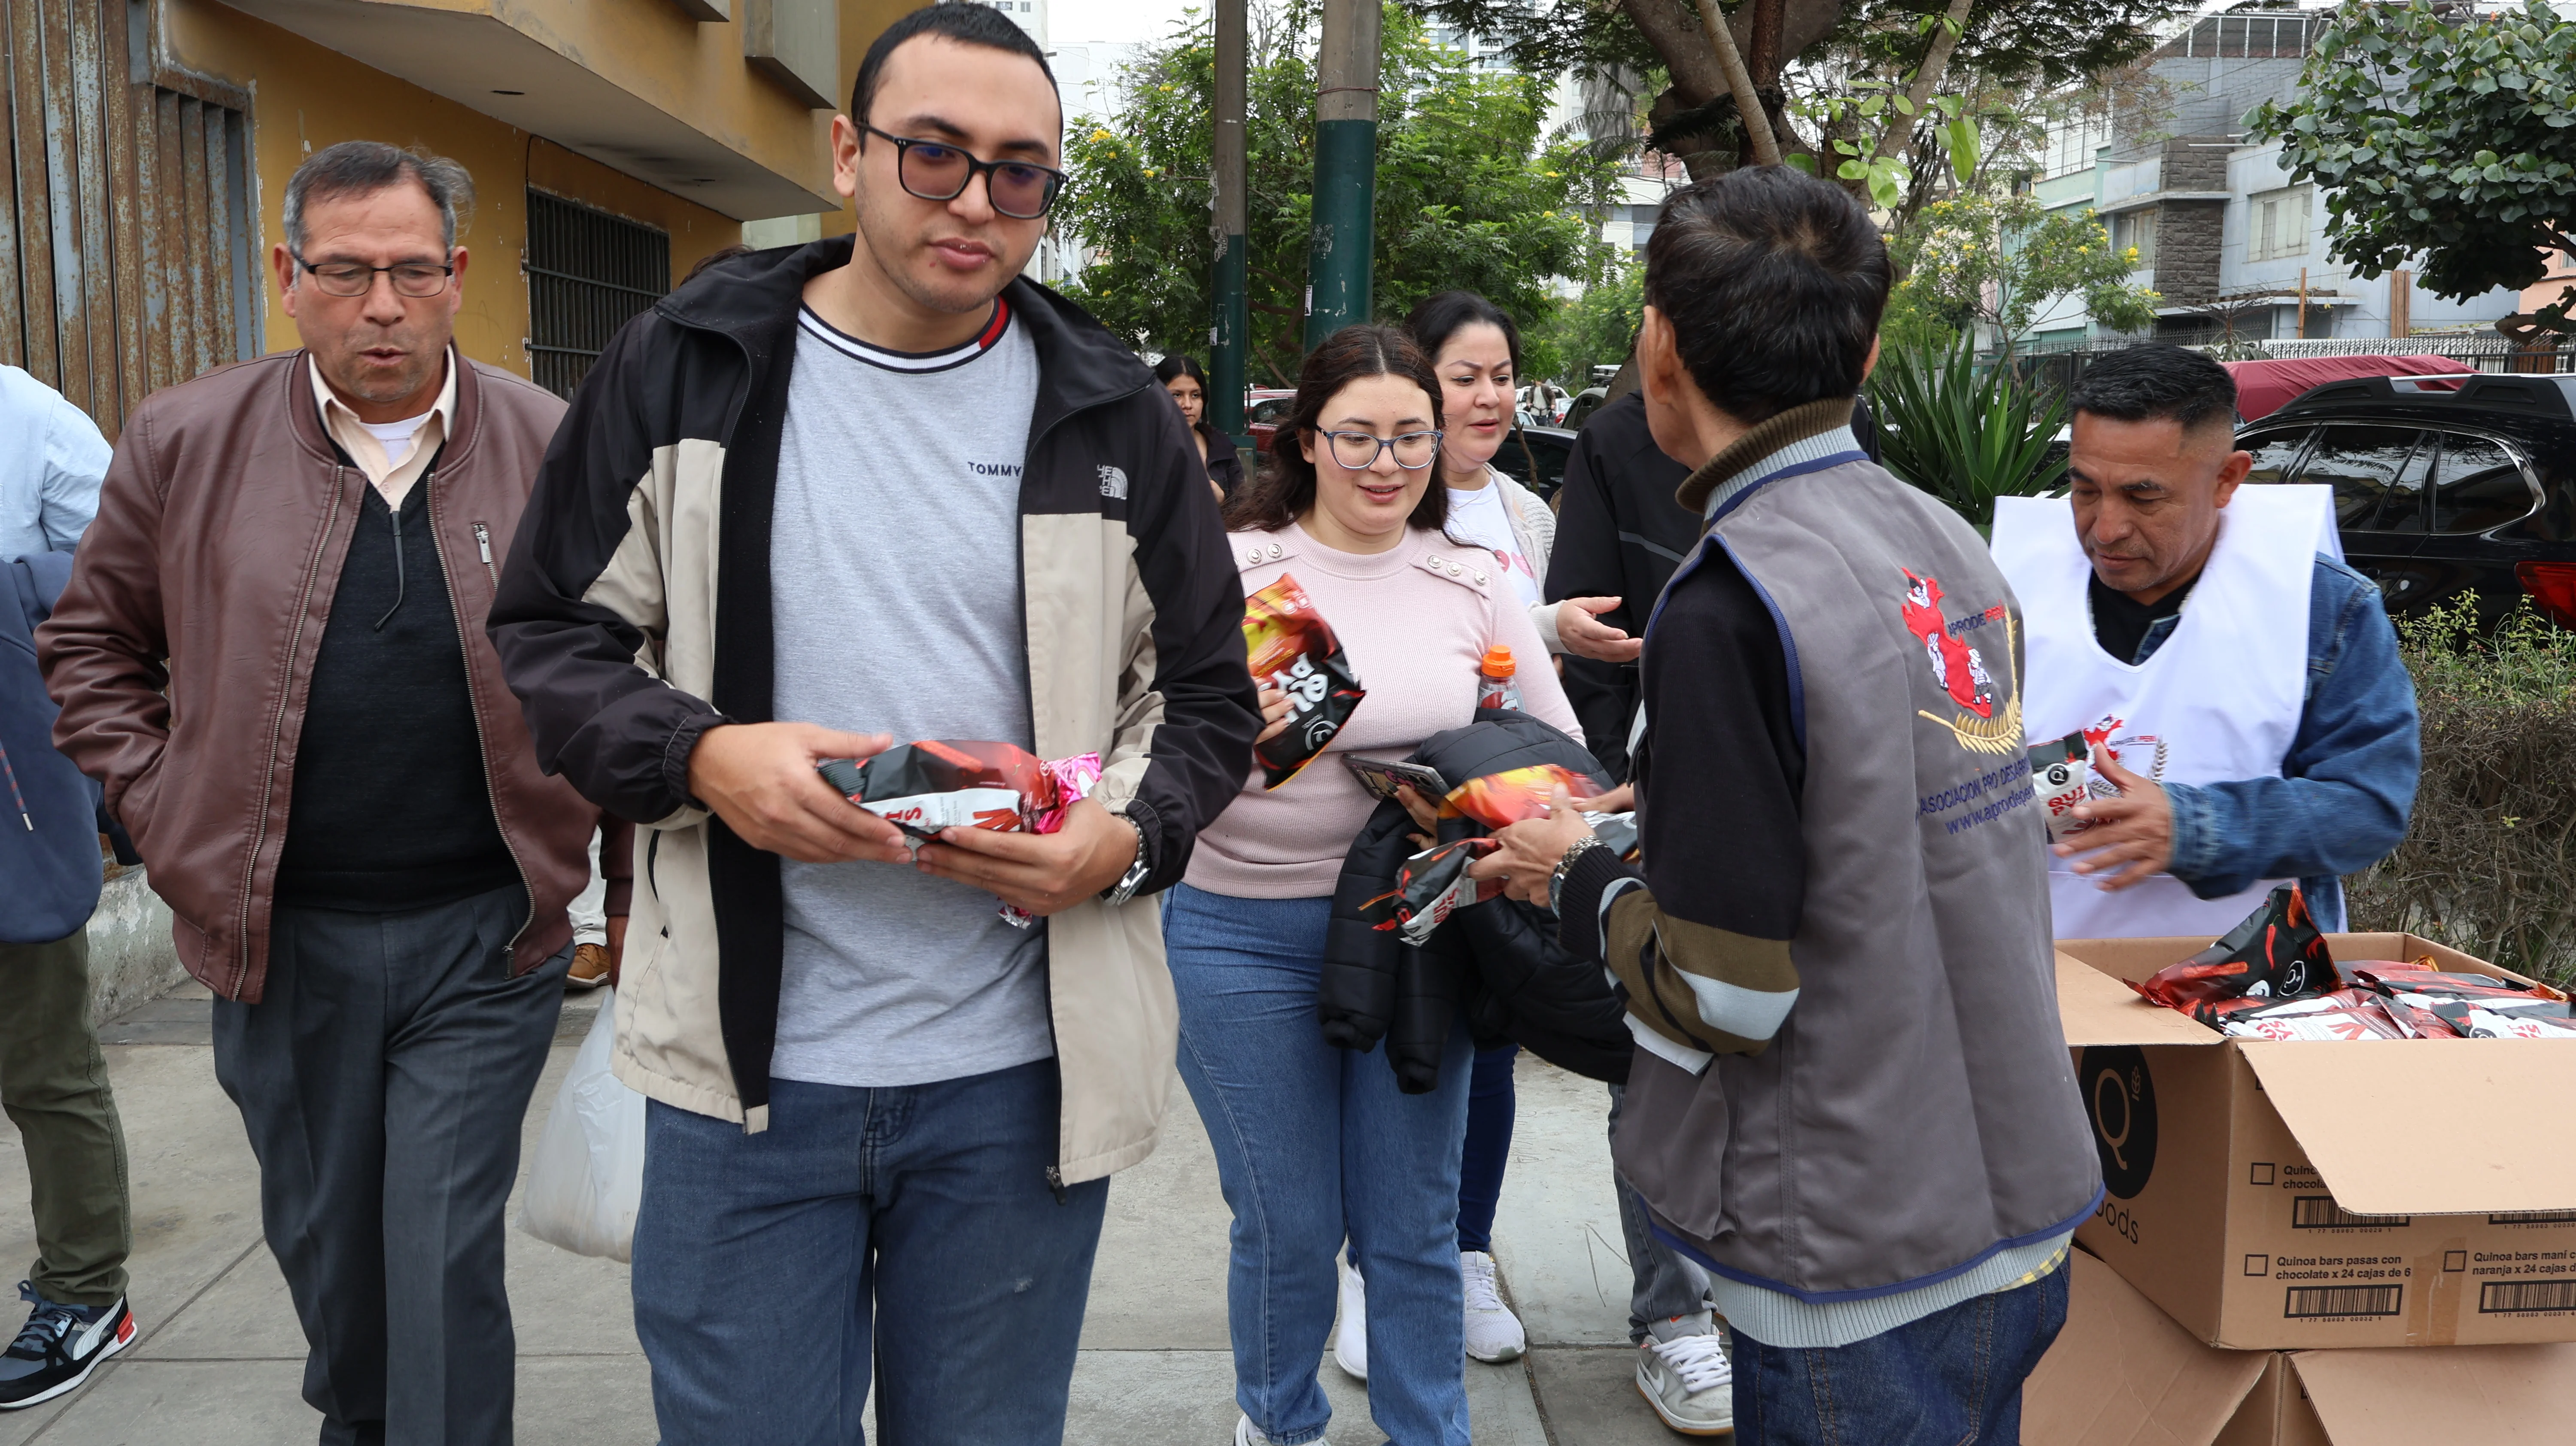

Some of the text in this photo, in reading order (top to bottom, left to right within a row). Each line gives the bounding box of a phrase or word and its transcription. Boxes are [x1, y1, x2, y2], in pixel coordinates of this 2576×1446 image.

[968, 461, 1022, 477] TOMMY
[1920, 779, 1982, 816] ASOCIACION
[1982, 772, 1998, 793] PRO
[2283, 1179, 2327, 1189] chocola
[2277, 1256, 2316, 1266] Quinoa
[2319, 1256, 2343, 1266] bars
[2346, 1256, 2378, 1267] pasas
[2474, 1252, 2512, 1262] Quinoa
[2515, 1252, 2538, 1261] bars
[2541, 1250, 2567, 1260] maní
[2276, 1269, 2329, 1279] chocolate
[2341, 1269, 2354, 1278] 24
[2357, 1268, 2385, 1279] cajas
[2388, 1268, 2402, 1277] de
[2405, 1268, 2411, 1277] 6
[2472, 1265, 2512, 1276] naranja
[2524, 1264, 2536, 1273] 24
[2539, 1264, 2567, 1275] cajas
